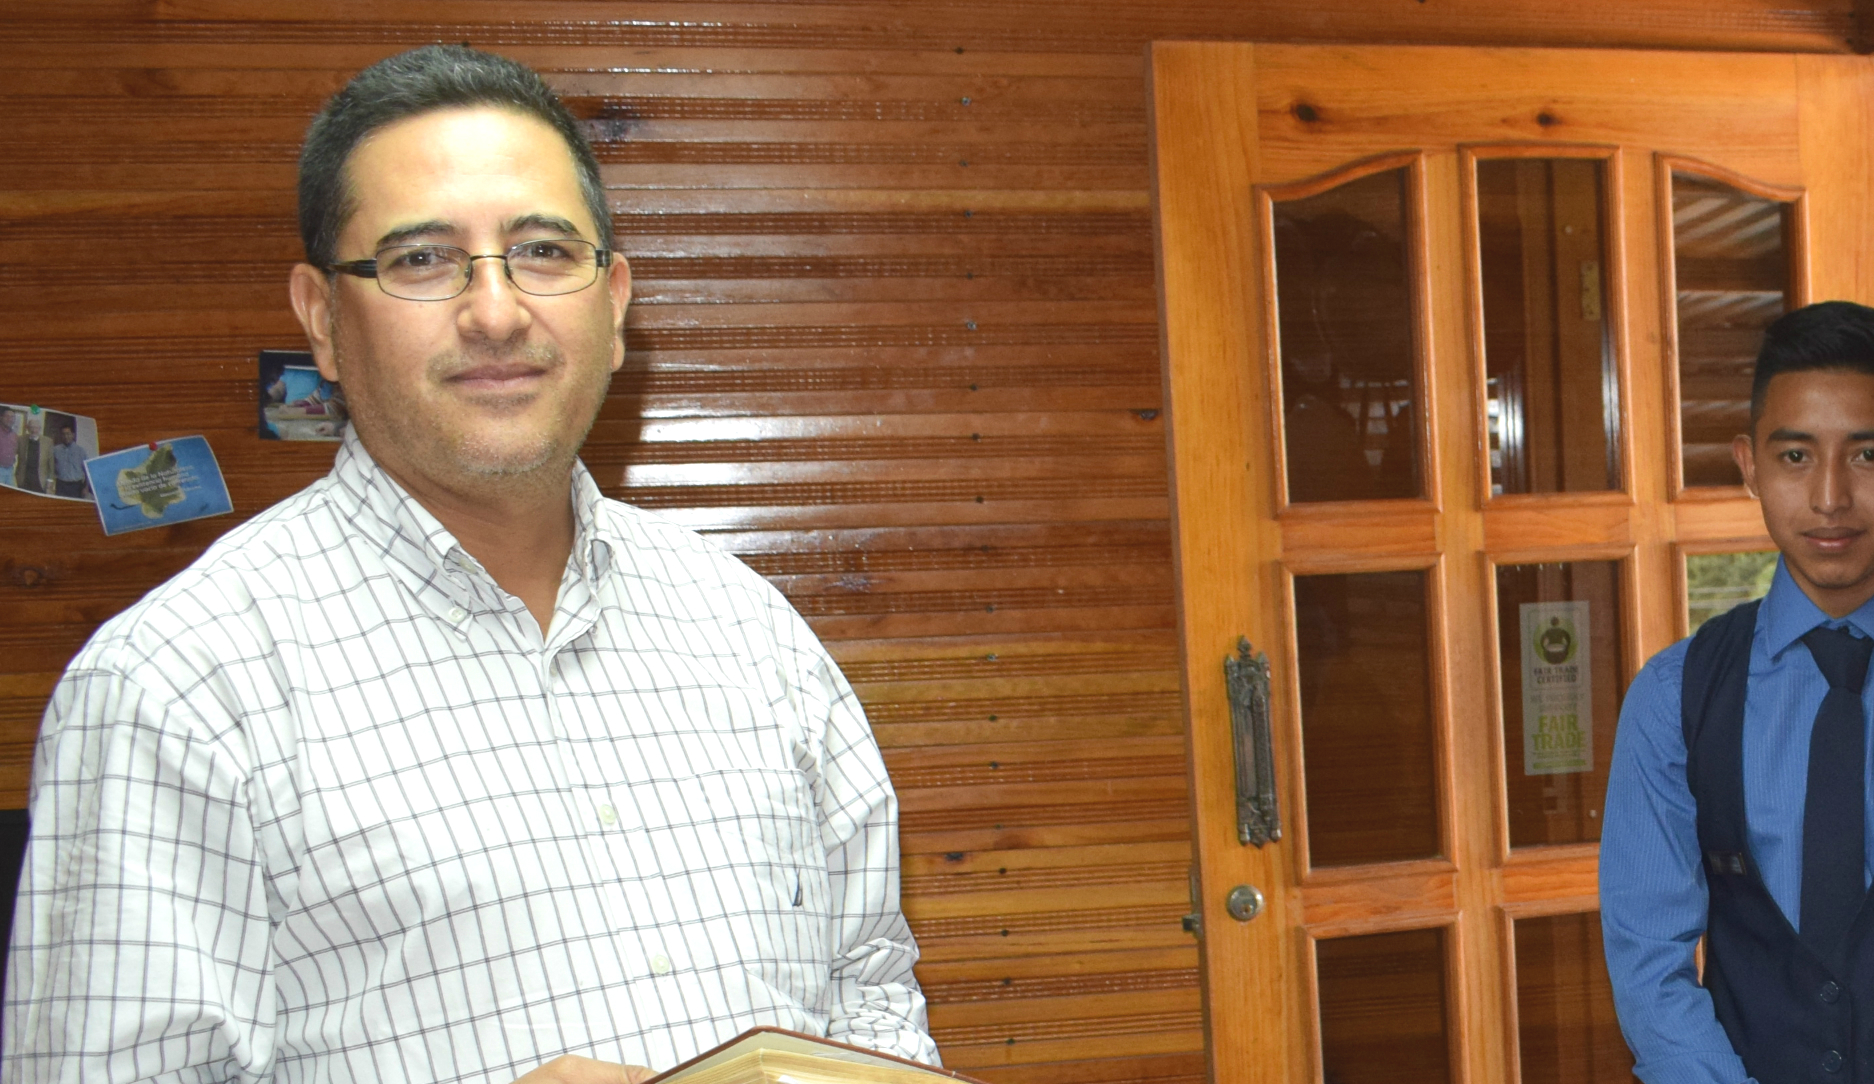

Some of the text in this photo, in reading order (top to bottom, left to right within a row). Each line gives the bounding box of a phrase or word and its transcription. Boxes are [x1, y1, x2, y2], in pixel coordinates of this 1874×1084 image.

[1533, 666, 1551, 676] FAIR
[1537, 674, 1577, 684] CERTIFIED
[1538, 713, 1578, 733] FAIR
[1532, 730, 1586, 751] TRADE
